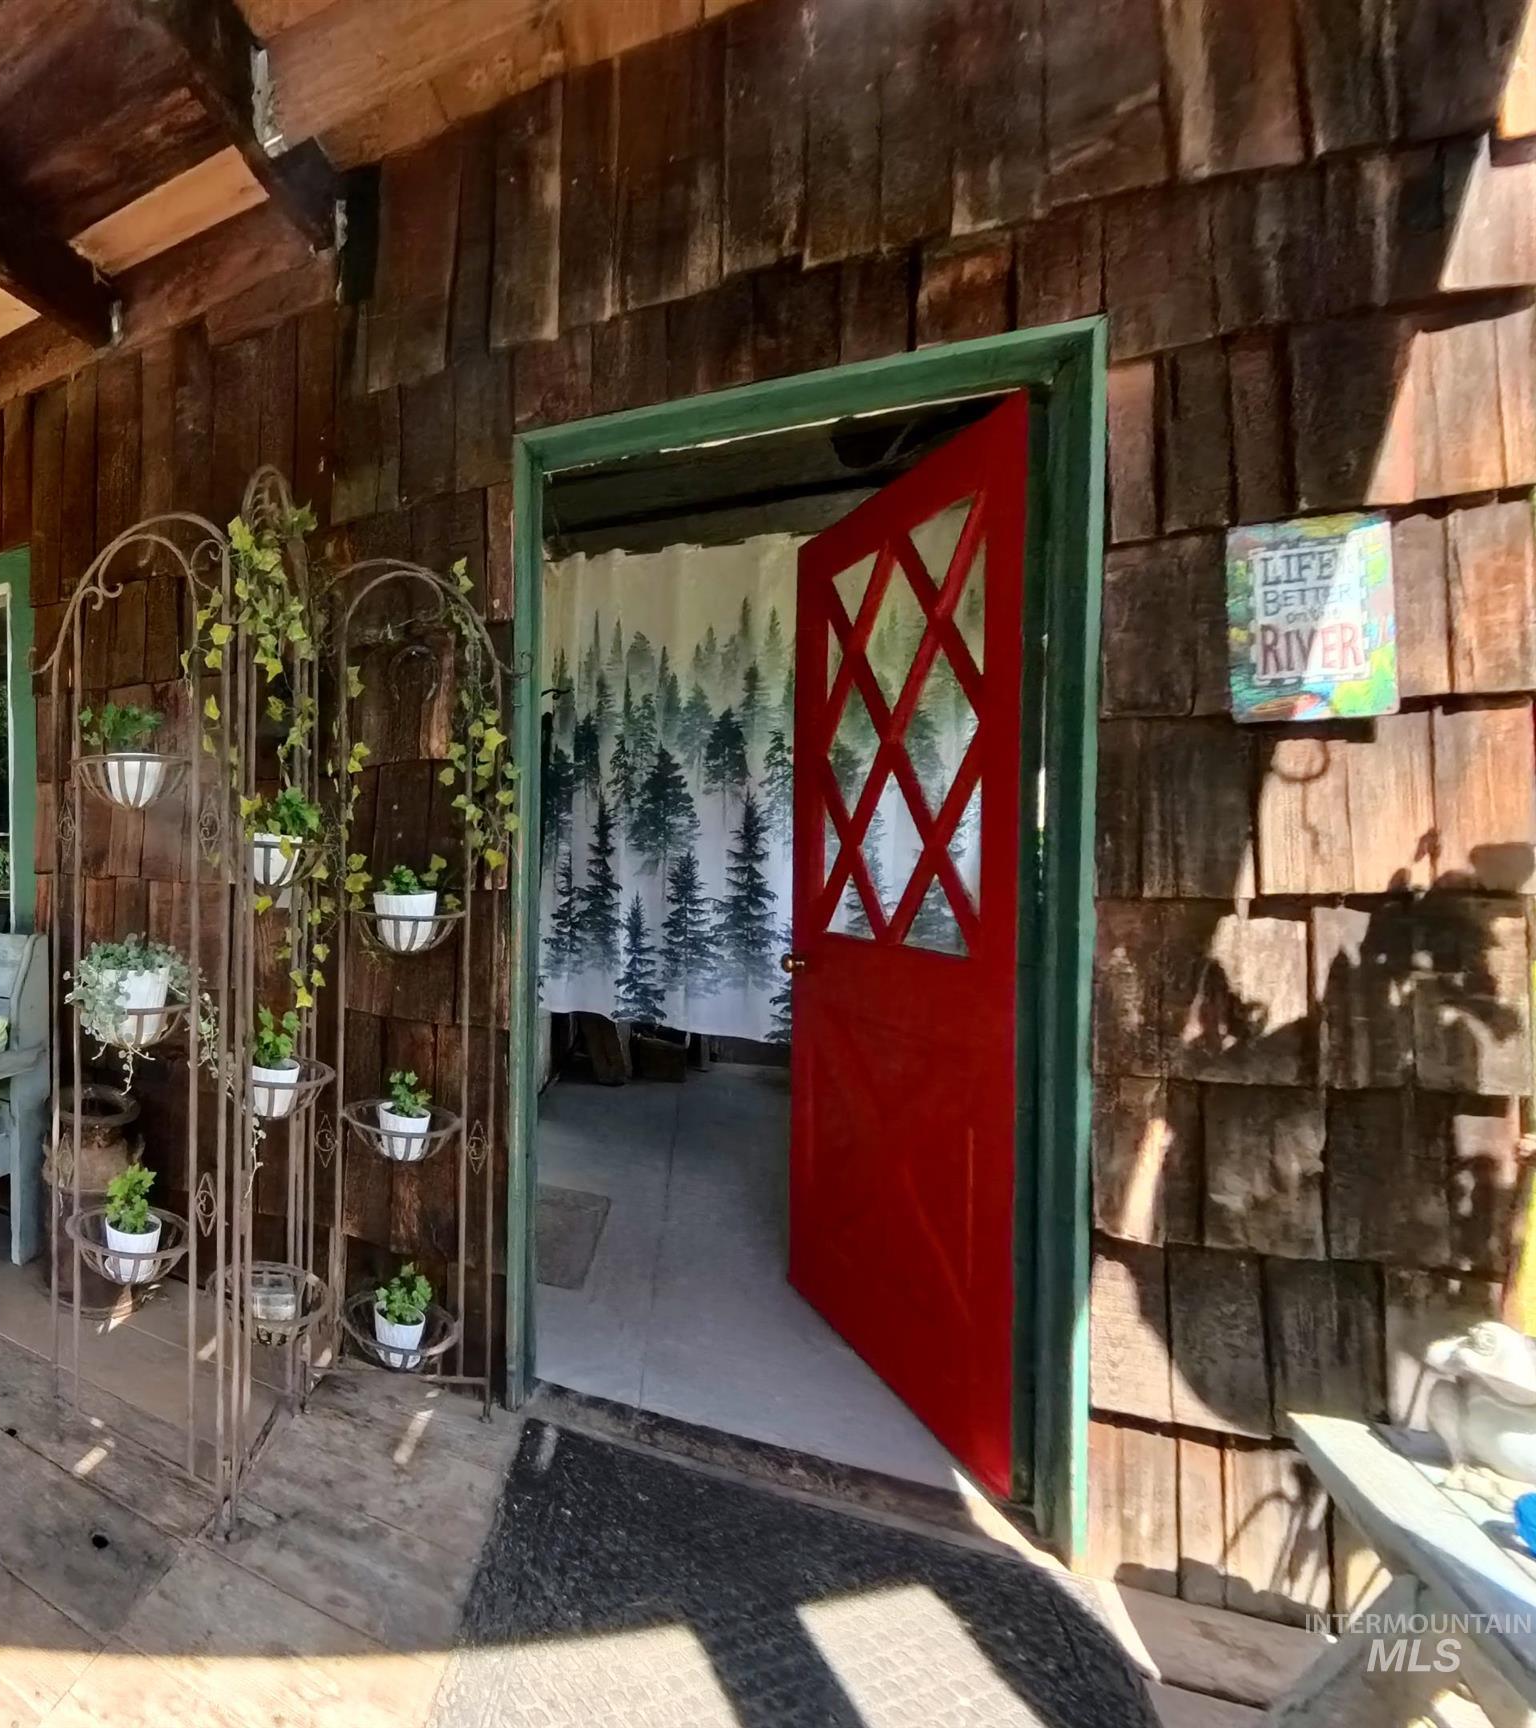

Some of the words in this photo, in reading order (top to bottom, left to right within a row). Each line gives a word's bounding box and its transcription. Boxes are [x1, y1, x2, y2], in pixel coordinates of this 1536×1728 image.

[1262, 549, 1339, 586] LIFE
[1263, 583, 1352, 617] BETTER
[1261, 622, 1362, 676] RIVER
